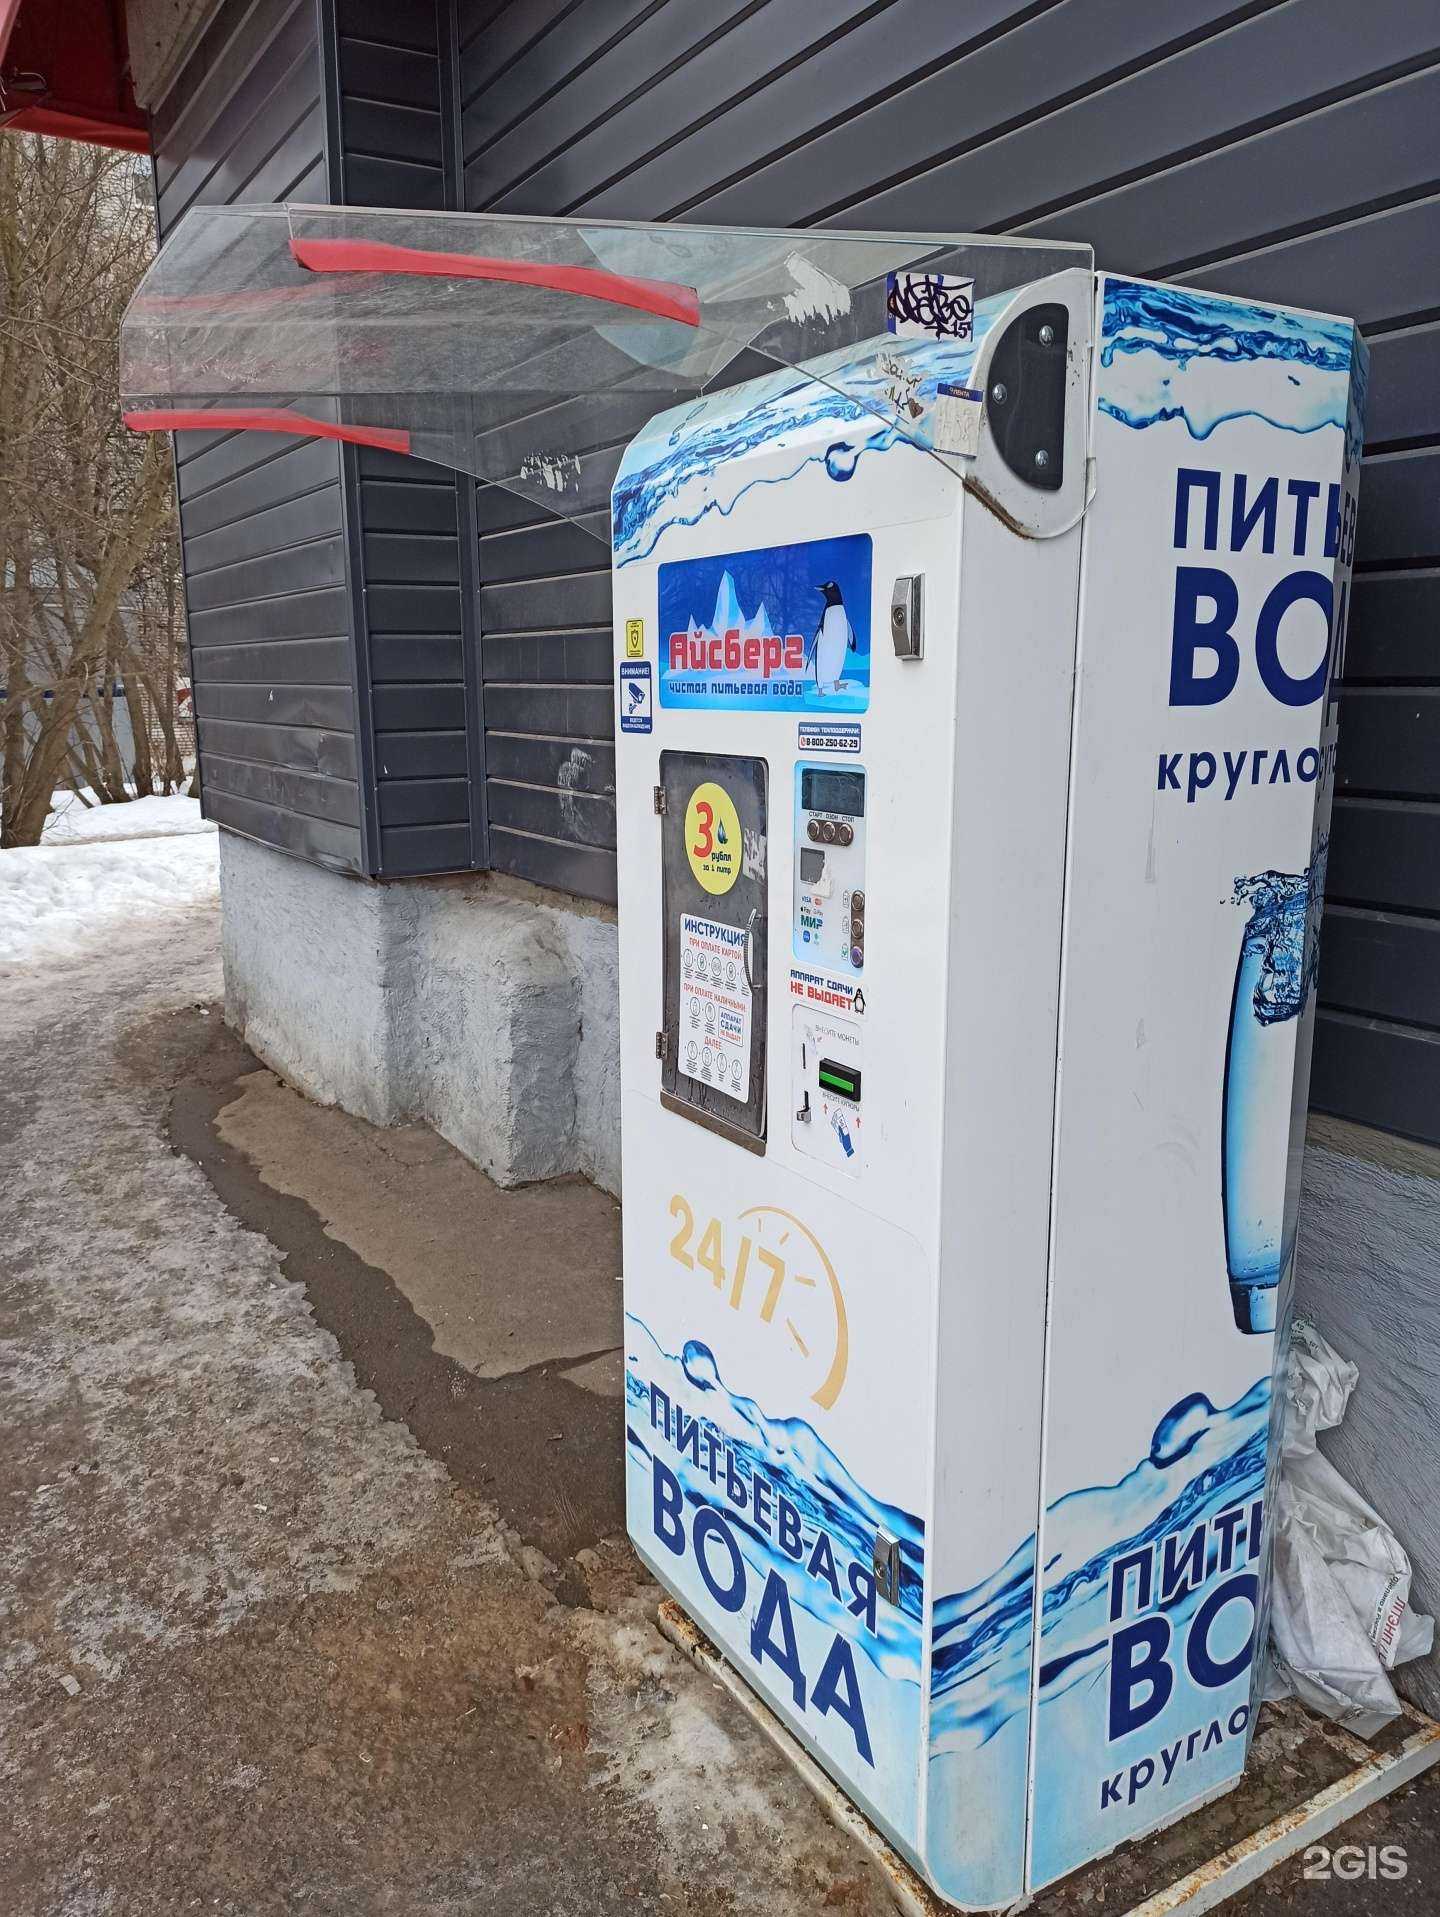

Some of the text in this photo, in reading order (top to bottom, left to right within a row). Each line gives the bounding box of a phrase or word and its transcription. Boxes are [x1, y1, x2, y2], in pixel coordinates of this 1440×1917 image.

[669, 629, 803, 678] Айсберг
[669, 680, 803, 695] чистая питьевая вода
[693, 801, 713, 858] 3
[684, 918, 746, 947] ИНСТРУКЦИЯ
[790, 969, 853, 996] АППАРАТ СДАЧИ
[790, 981, 854, 1011] НЕ ВЫДАЕТ
[669, 1194, 786, 1324] 24/7
[649, 1380, 878, 1638] ПИТЬЕВАЯ
[652, 1453, 876, 1769] ВОДА
